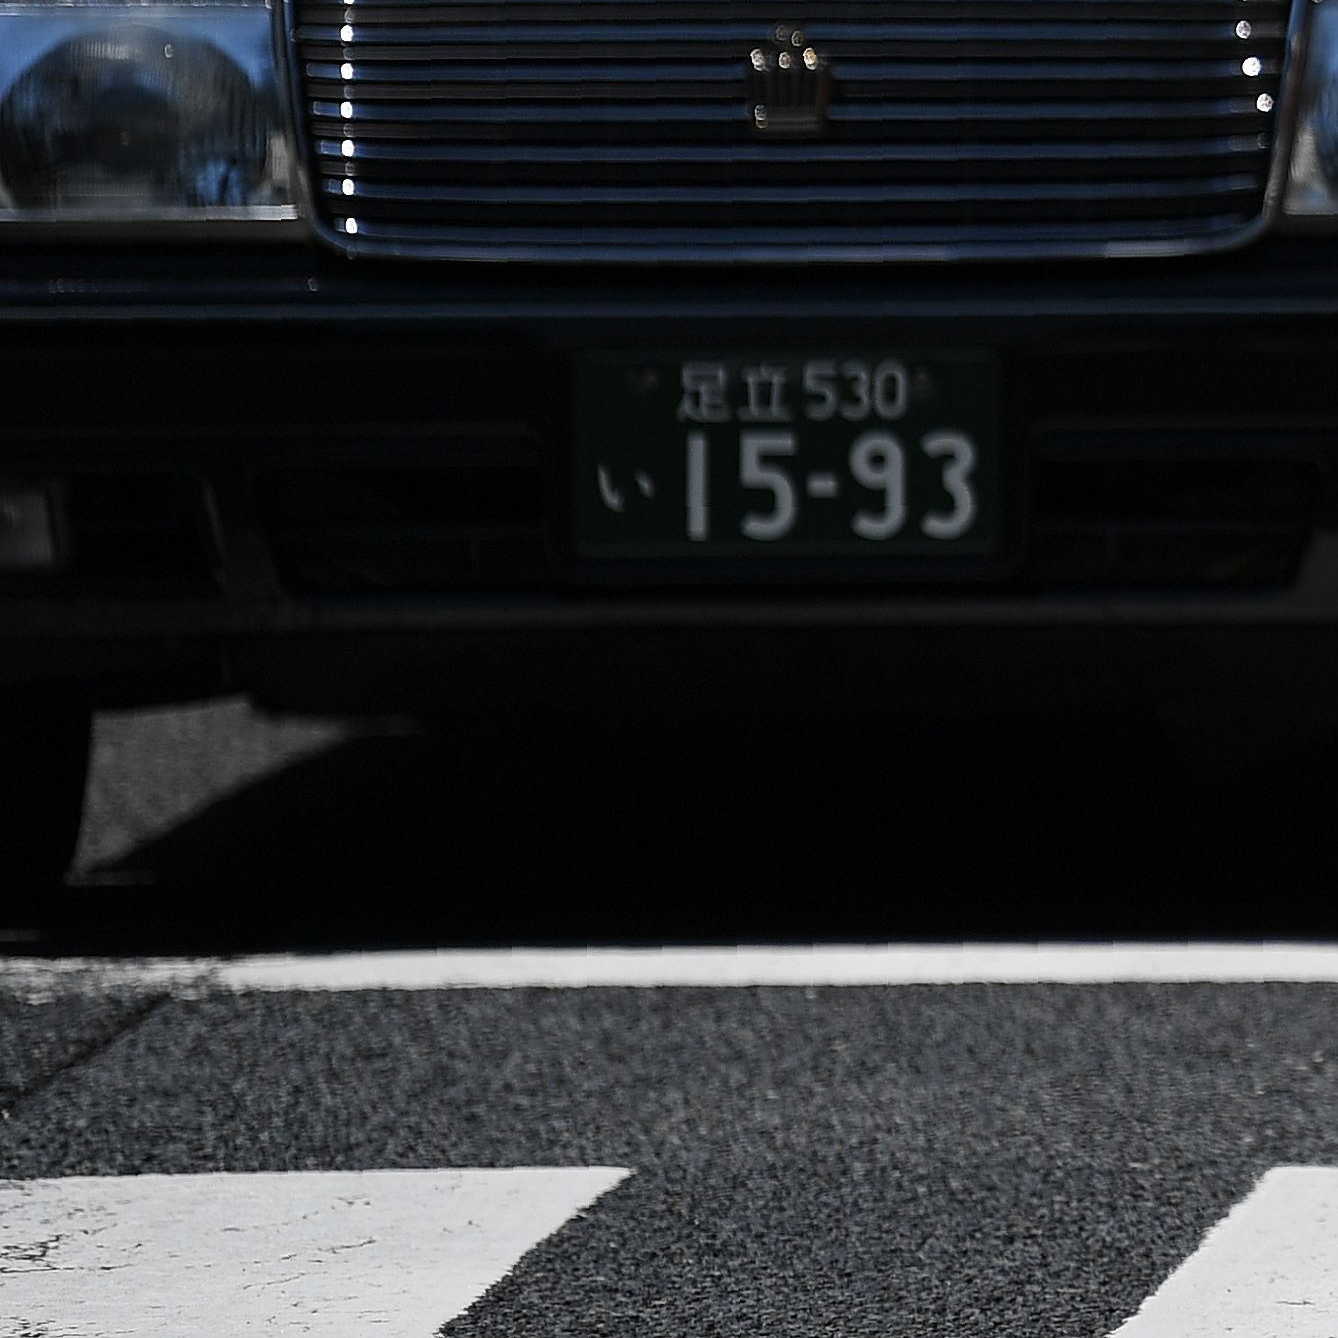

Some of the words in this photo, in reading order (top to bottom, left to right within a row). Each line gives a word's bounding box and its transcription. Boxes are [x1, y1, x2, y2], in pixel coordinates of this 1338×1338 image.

[677, 362, 793, 422] 足立
[803, 362, 908, 421] 530
[686, 429, 978, 541] 15-93
